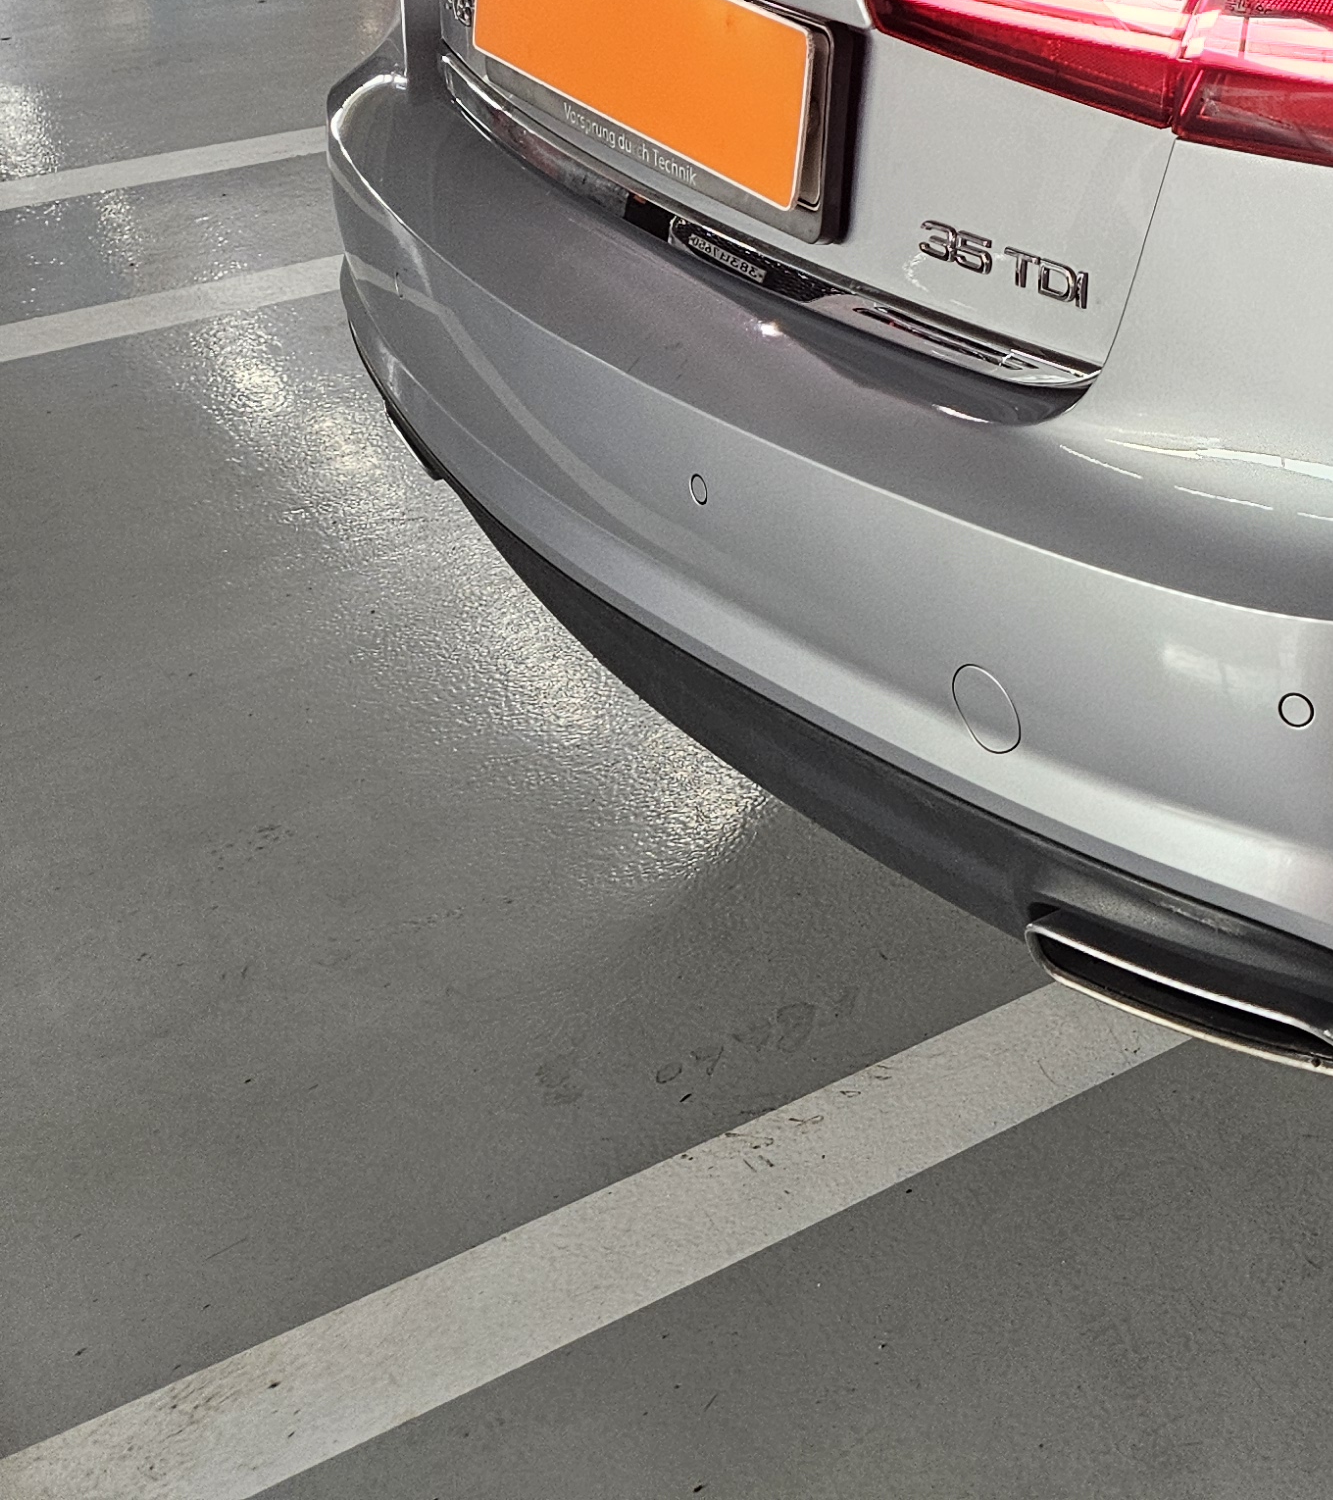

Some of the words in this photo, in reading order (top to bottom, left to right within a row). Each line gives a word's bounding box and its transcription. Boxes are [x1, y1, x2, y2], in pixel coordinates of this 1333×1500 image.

[562, 101, 617, 149] Vorsprung
[652, 148, 697, 187] Technik
[919, 219, 993, 275] 35
[1004, 246, 1089, 309] TDI
